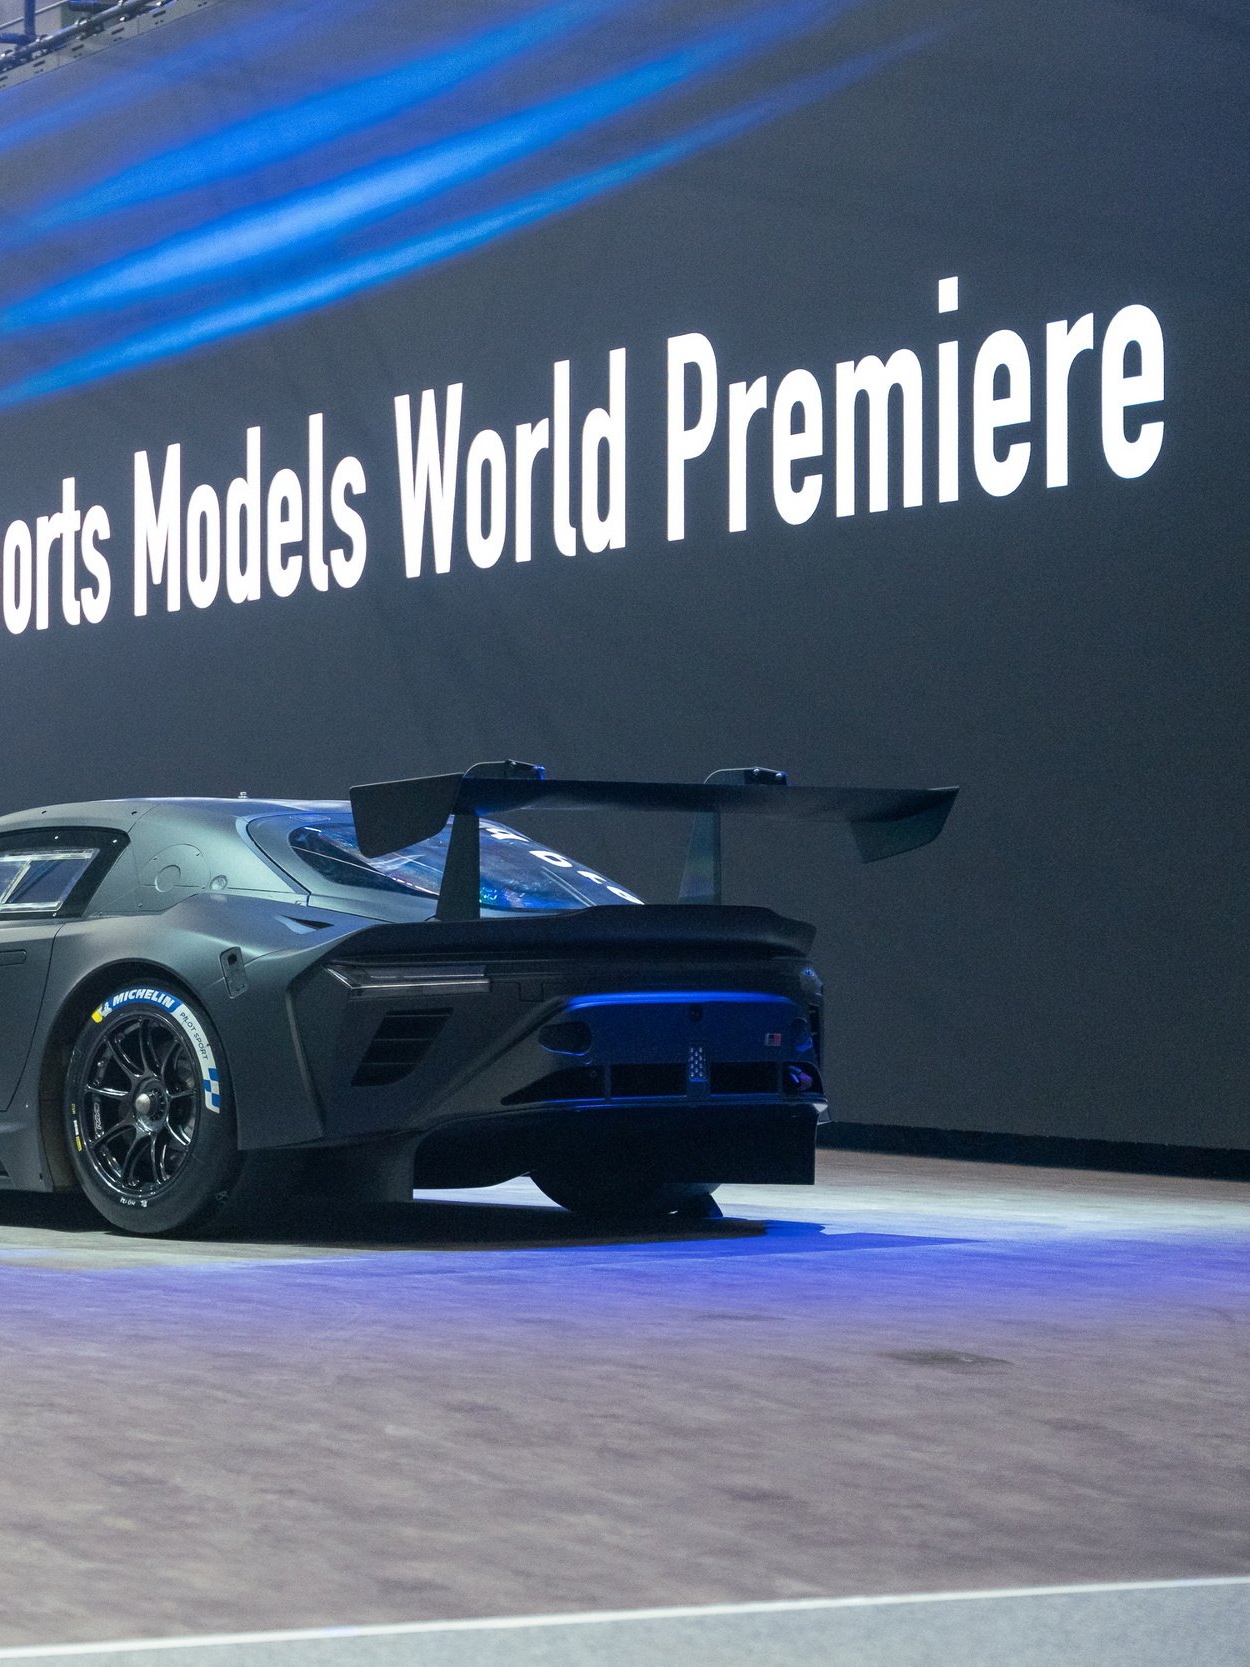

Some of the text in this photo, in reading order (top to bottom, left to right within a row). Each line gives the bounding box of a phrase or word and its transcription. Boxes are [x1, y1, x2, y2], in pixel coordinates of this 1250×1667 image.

[133, 412, 368, 617] Models
[393, 347, 627, 579] World
[666, 275, 1165, 542] Premiere
[112, 988, 176, 1009] MICHELIN
[179, 1012, 209, 1060] PILOT SPORT
